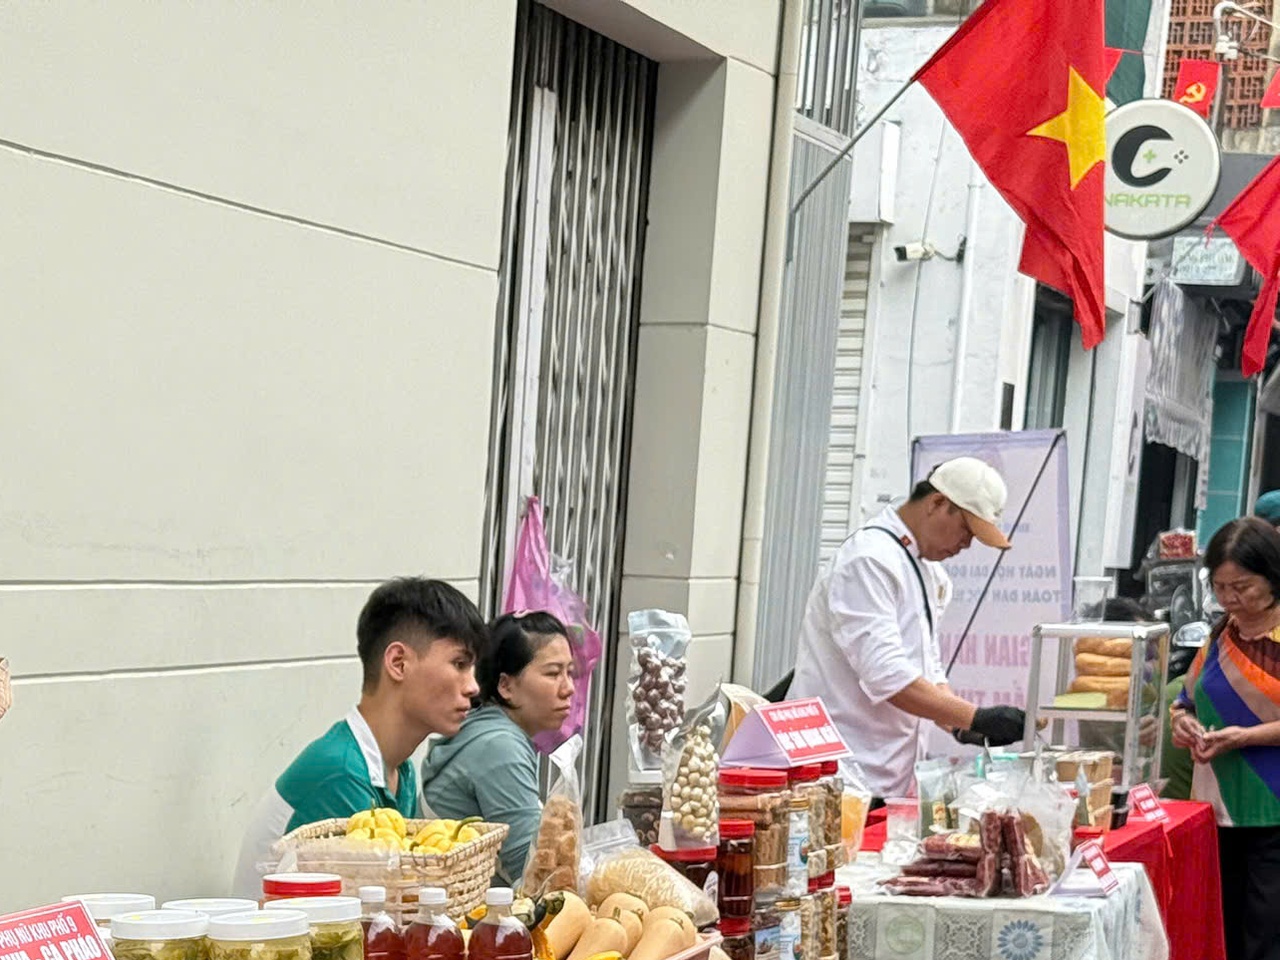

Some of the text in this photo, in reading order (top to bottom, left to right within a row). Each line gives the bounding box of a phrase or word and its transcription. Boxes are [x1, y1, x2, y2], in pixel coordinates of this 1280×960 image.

[29, 922, 52, 943] KHU
[49, 912, 70, 938] PHỐ
[68, 916, 78, 932] 9
